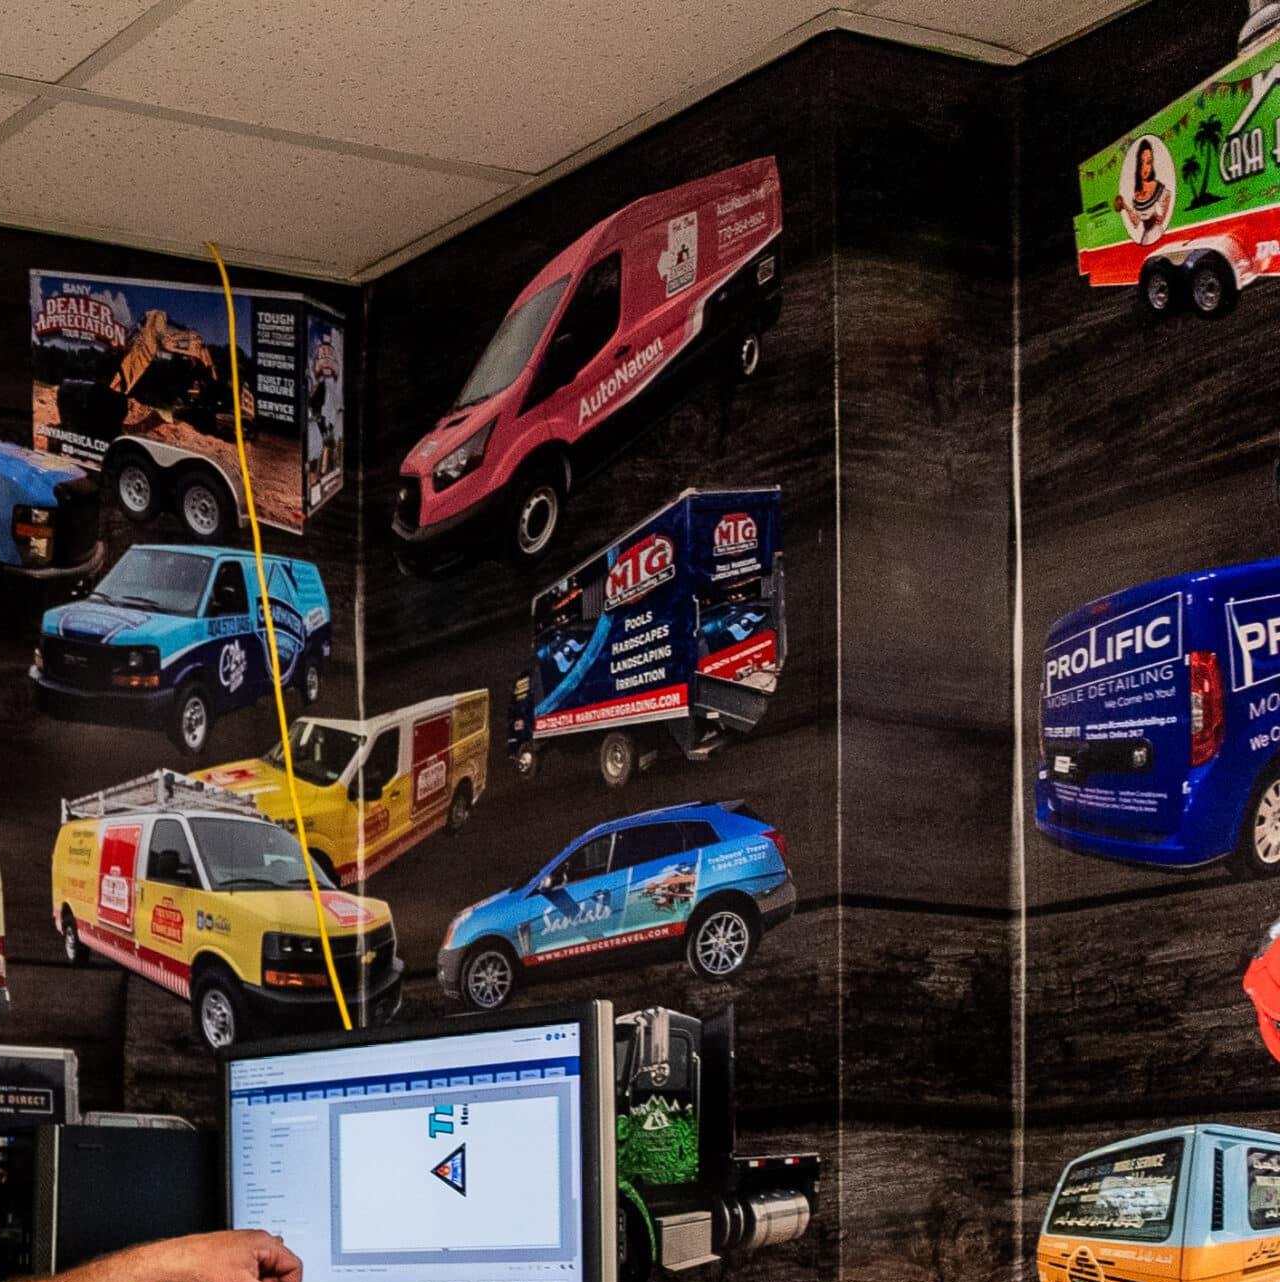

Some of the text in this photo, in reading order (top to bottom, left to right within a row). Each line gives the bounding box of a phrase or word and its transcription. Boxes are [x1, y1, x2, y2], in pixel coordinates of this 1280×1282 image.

[1220, 127, 1265, 183] CASA
[46, 297, 113, 326] DEALER
[257, 312, 295, 324] TOUGH
[35, 313, 127, 347] APPRECIATION
[578, 336, 664, 426] AutoNation
[257, 399, 295, 415] SERVICE
[717, 513, 757, 546] MTG
[609, 535, 676, 599] MTG
[624, 610, 653, 632] POOLS
[611, 624, 670, 656] HARDSCAPES
[610, 644, 672, 674] LANDSCAPING
[1046, 616, 1172, 697] PROLIFIC
[615, 667, 666, 692] IRRIGATION
[1047, 664, 1175, 710] MOBILE DETAILING
[1117, 695, 1144, 707] Come
[1143, 692, 1155, 701] to
[1155, 685, 1177, 699] You!
[541, 901, 612, 936] Sandals
[8, 1094, 46, 1106] DIRECT
